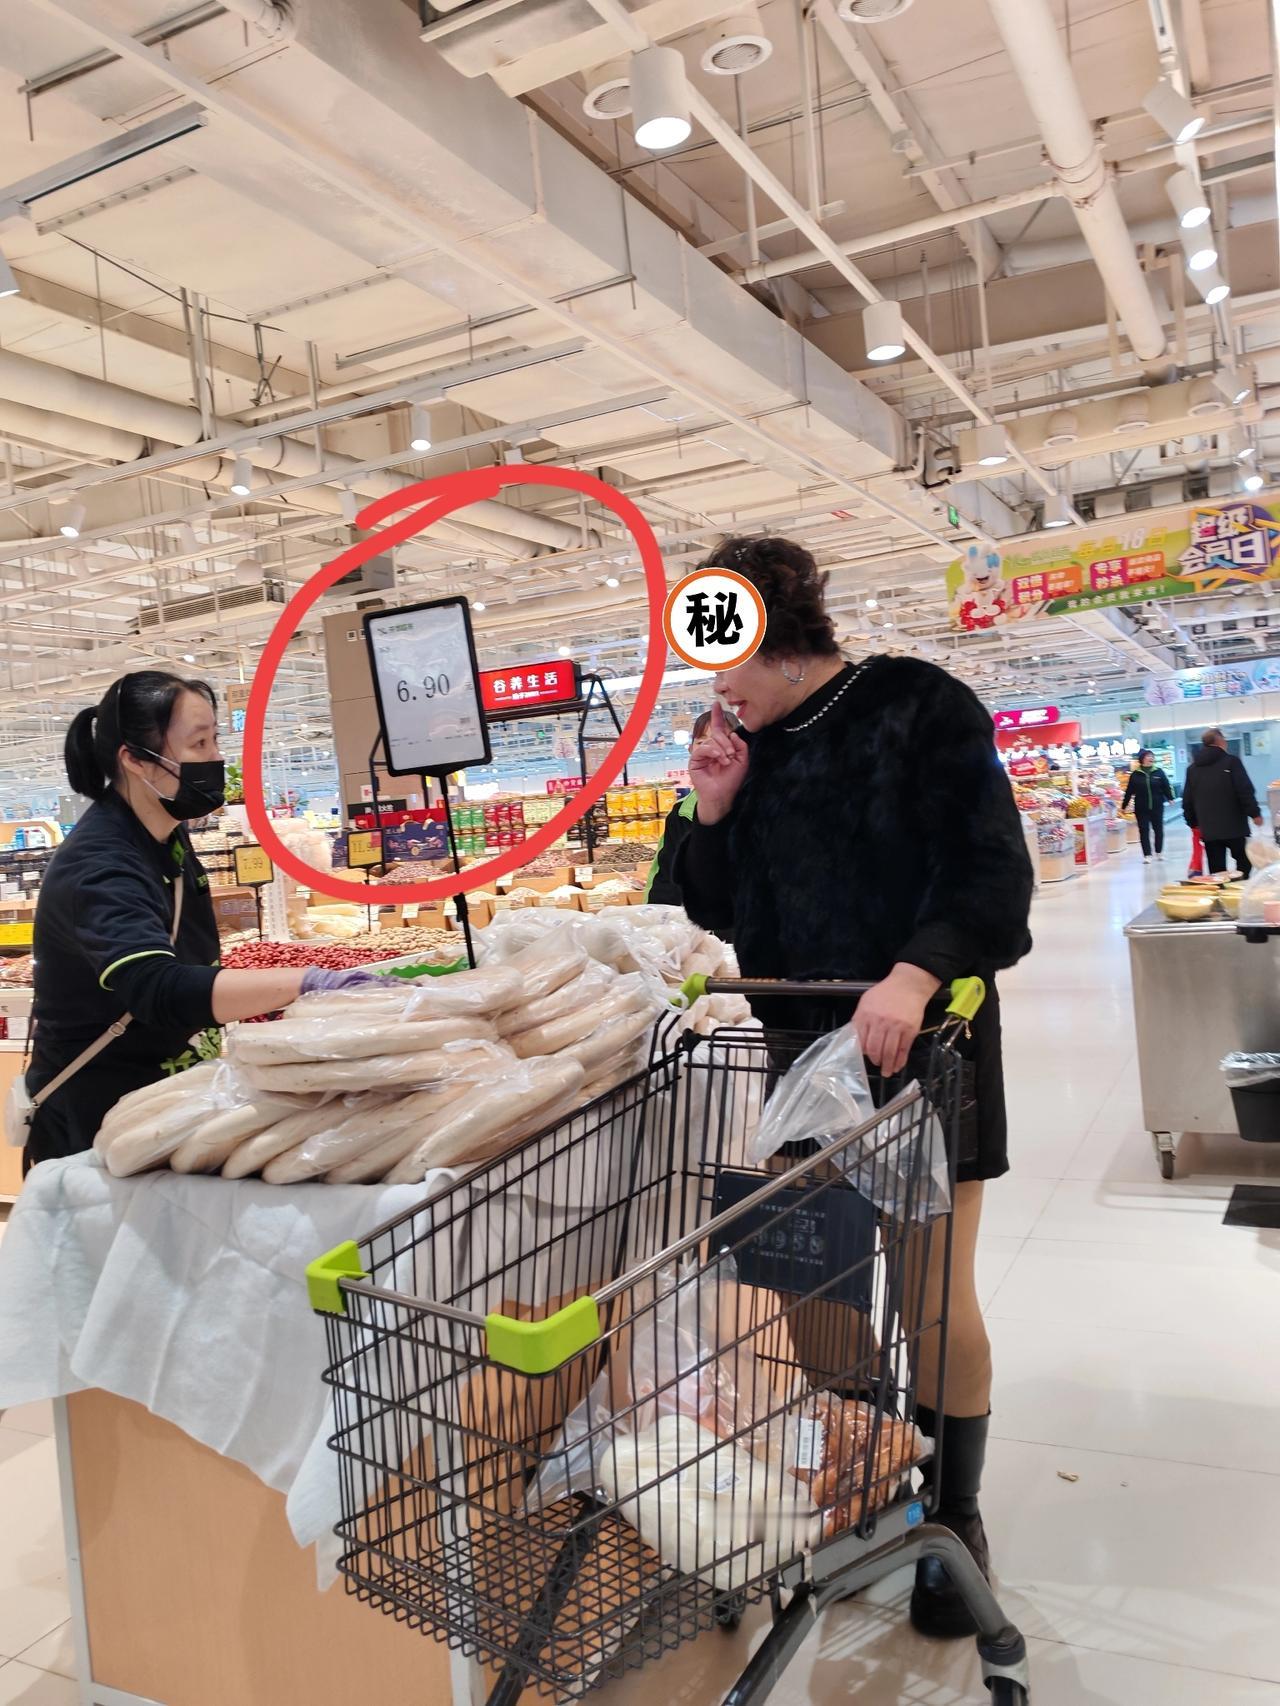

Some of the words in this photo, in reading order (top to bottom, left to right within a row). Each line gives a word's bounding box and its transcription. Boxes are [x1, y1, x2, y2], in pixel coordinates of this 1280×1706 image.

[1190, 505, 1250, 545] 超级
[1176, 529, 1268, 576] 会员日
[1093, 559, 1122, 574] 专享
[1016, 574, 1043, 589] 双倍
[1095, 574, 1124, 590] 秒杀
[397, 673, 450, 702] 6.90
[493, 671, 558, 693] 谷养生活
